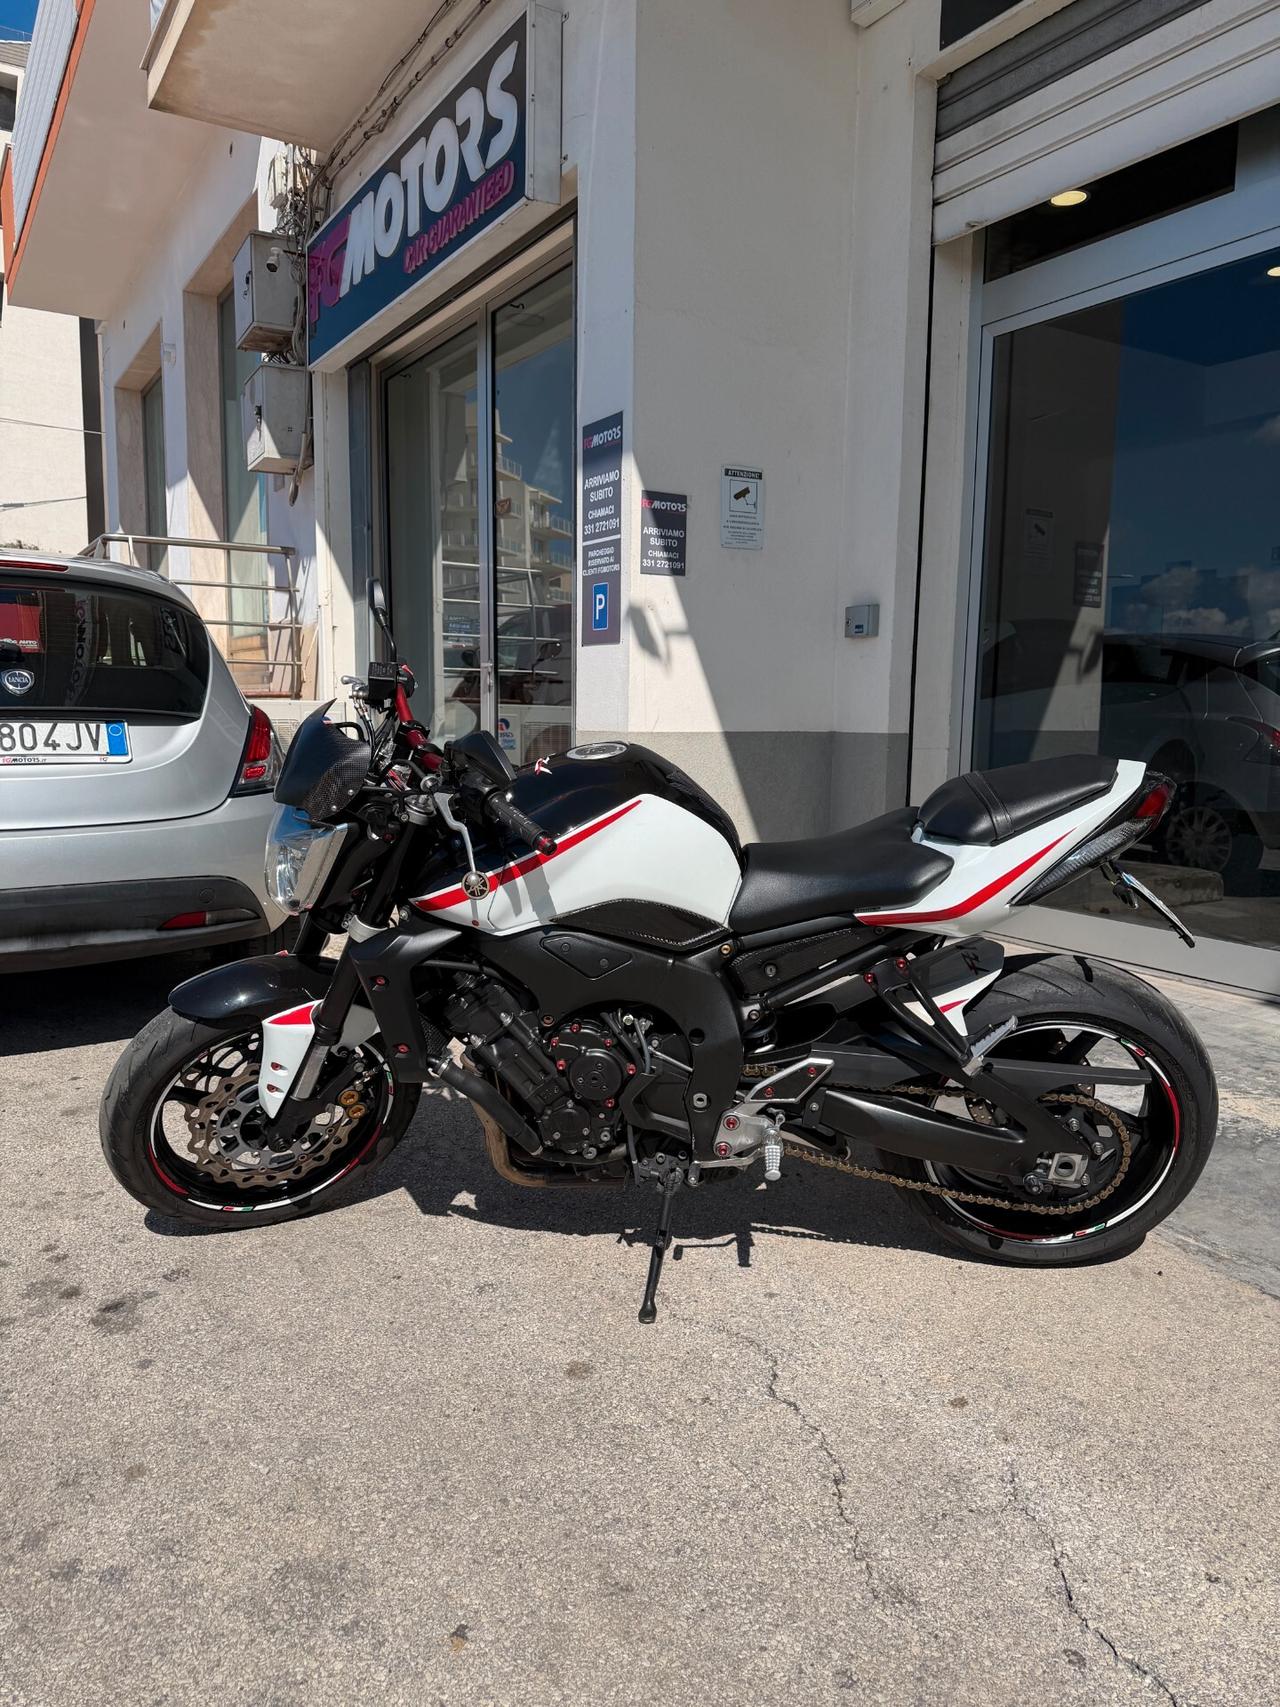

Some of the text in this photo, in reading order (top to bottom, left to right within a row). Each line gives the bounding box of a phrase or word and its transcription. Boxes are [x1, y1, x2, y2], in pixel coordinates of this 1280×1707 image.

[584, 469, 620, 490] ARRIVIAMO
[728, 469, 760, 479] ATTENZIONE
[590, 486, 614, 502] SUBITO
[588, 505, 615, 520] CHIAMACI
[584, 518, 620, 535] 331 2721091
[643, 526, 684, 538] ARRIVIAMO
[650, 537, 678, 547] SUBITO
[588, 546, 615, 558] PARCHEGGIO
[648, 550, 679, 559] CHIAMACI
[588, 557, 610, 567] RISERVATO
[642, 559, 685, 569] 331 2721091
[582, 565, 598, 576] CLIENTI
[595, 593, 605, 620] P
